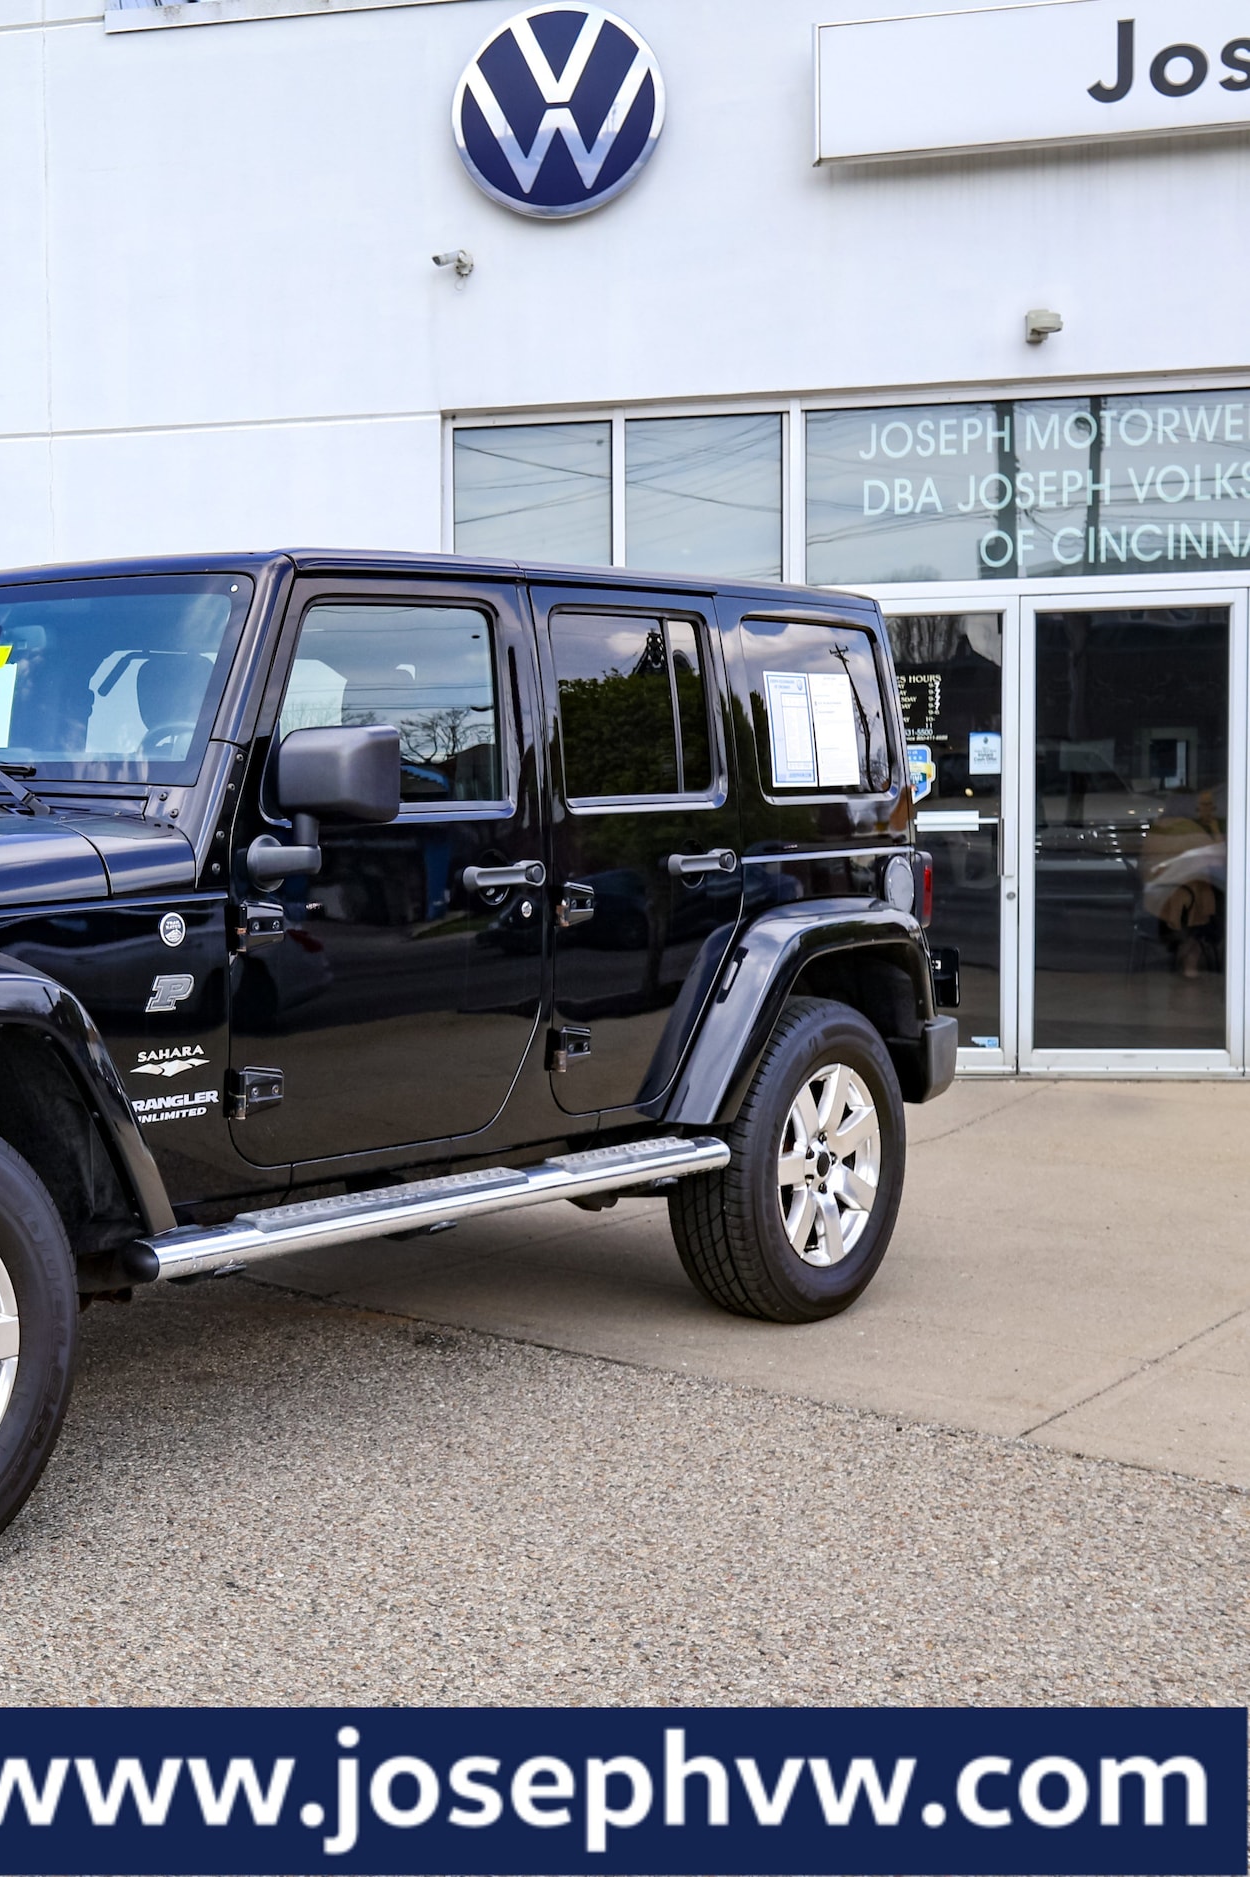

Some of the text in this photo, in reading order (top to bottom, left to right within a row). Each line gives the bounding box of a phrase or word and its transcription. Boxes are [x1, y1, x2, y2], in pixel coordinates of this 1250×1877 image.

[859, 415, 1011, 461] JOSEPH
[863, 477, 943, 516] DBA
[957, 468, 1111, 513] JOSEPH
[979, 529, 1034, 568] OF
[137, 1044, 205, 1062] SAHARA
